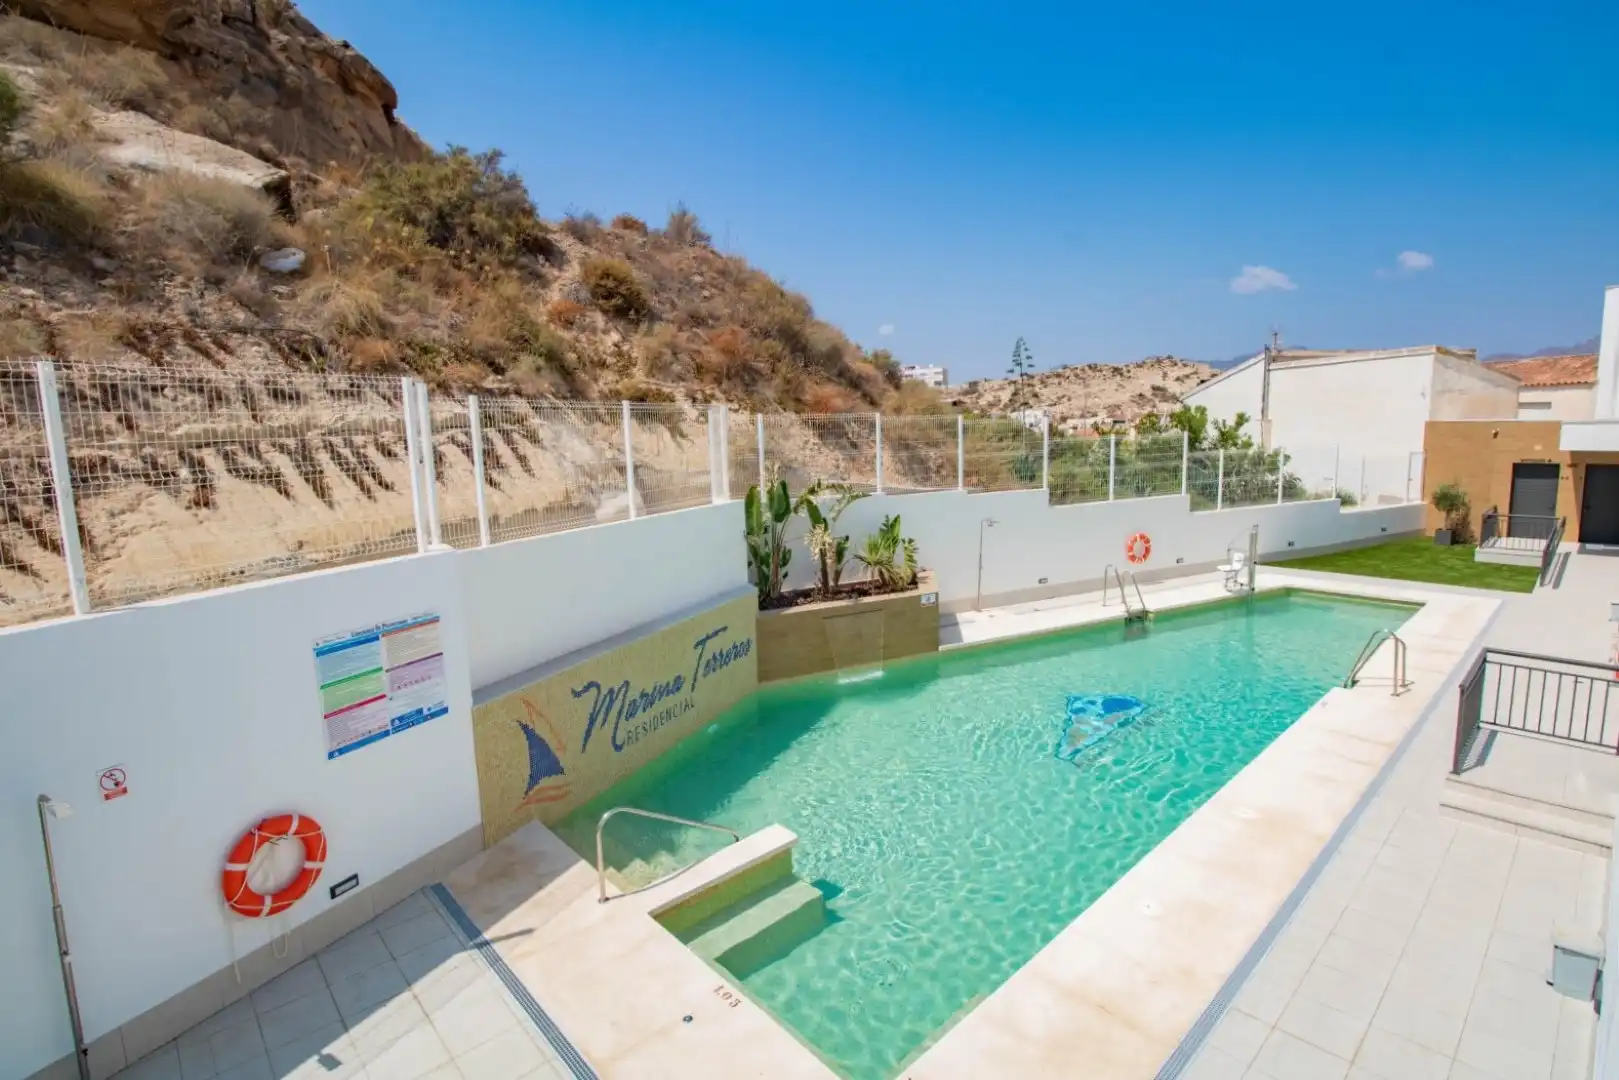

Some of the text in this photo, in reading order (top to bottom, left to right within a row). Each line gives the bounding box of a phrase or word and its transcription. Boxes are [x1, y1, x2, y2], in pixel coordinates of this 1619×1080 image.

[571, 626, 752, 754] Marina Terreros
[625, 695, 695, 747] RESIDENCIAL
